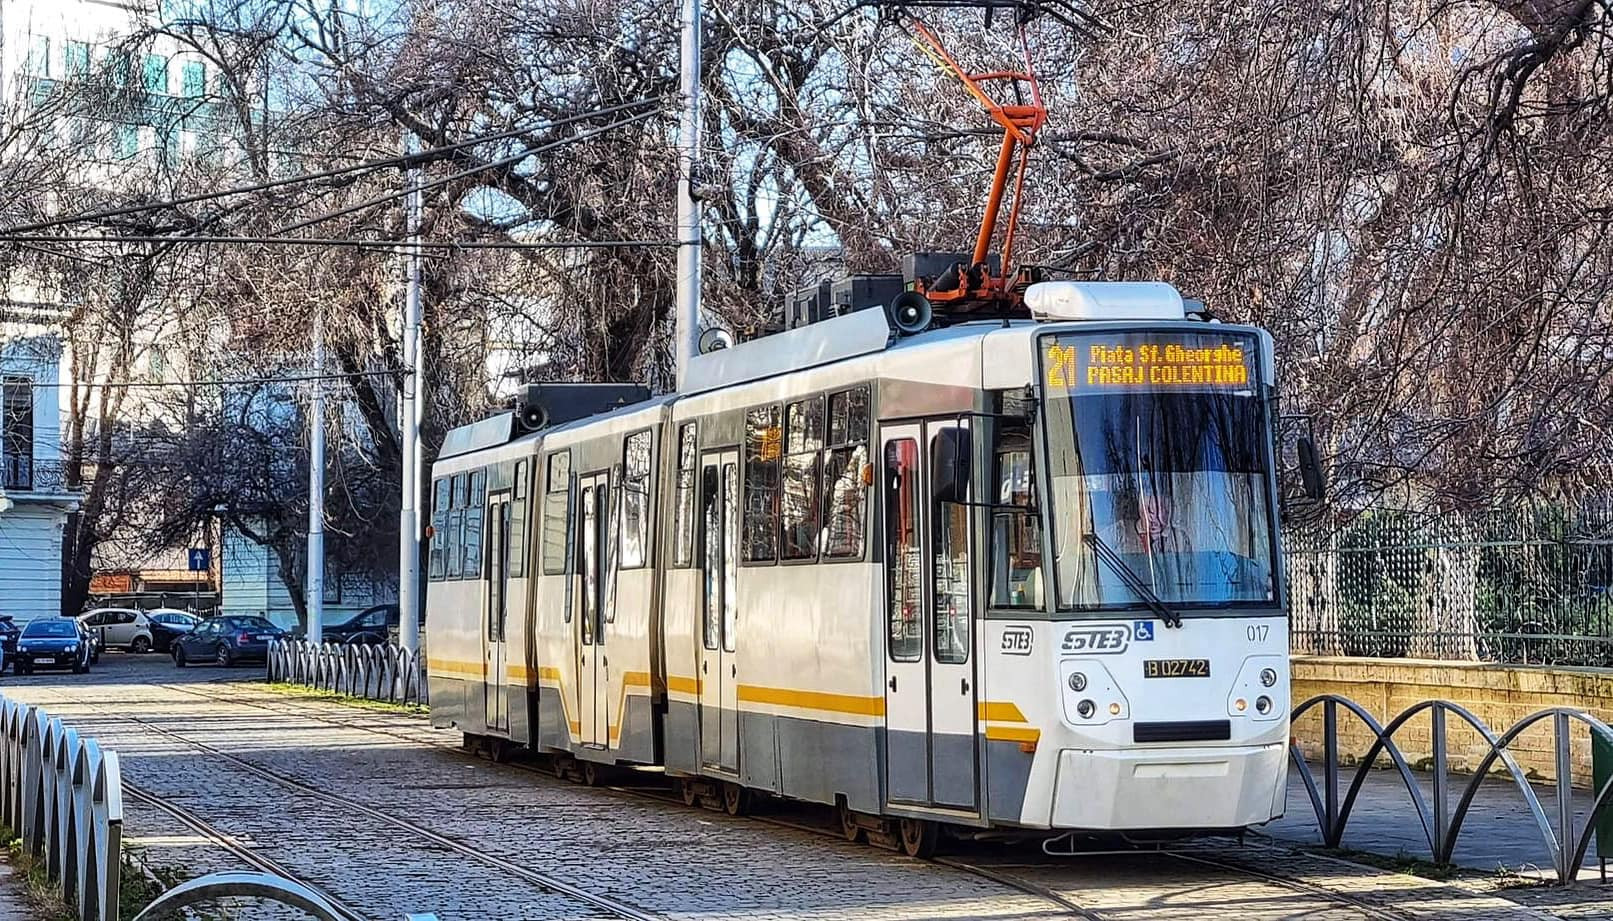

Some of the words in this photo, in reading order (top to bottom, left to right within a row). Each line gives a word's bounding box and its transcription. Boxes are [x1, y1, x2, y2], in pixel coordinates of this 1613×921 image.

[1139, 344, 1163, 363] Sf.
[1165, 344, 1242, 363] Gheorghe
[1048, 345, 1076, 386] 21
[1087, 366, 1144, 385] PASAJ
[1149, 365, 1247, 385] COLENTINA
[1001, 630, 1031, 650] STB
[1061, 630, 1124, 650] STB
[1246, 624, 1270, 642] 017
[1148, 661, 1158, 676] B
[1162, 660, 1206, 676] 02742
